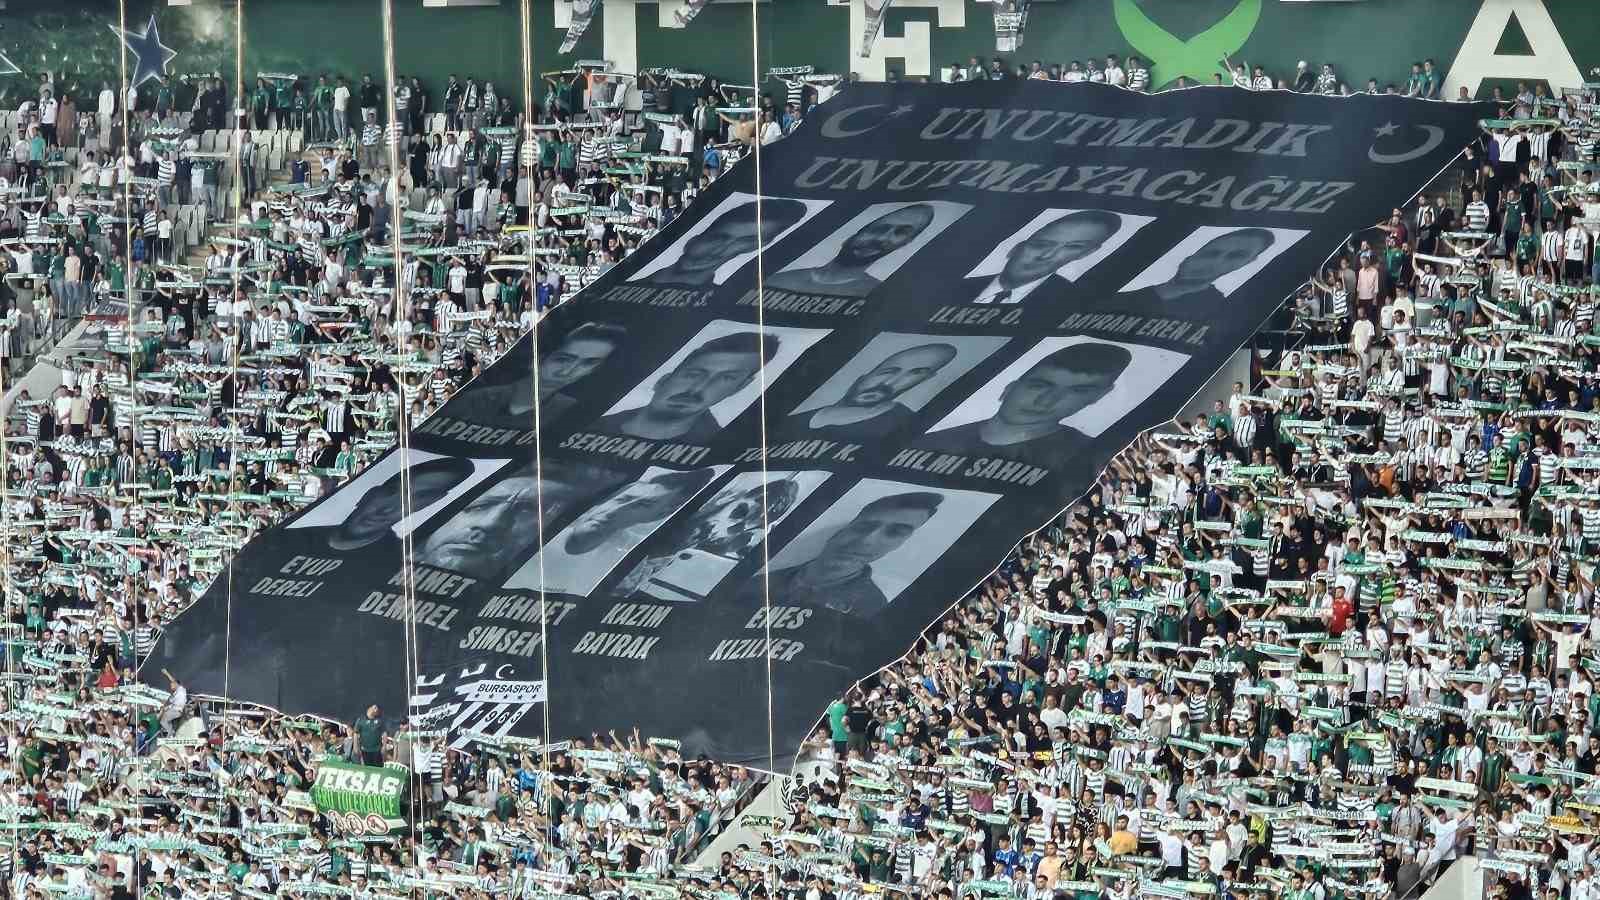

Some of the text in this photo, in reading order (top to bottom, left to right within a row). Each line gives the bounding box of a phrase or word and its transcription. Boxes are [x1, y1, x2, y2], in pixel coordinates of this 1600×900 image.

[920, 107, 1333, 158] UNUTMADIK
[794, 156, 1356, 214] UNUTMAYACAĞIZ
[929, 305, 1001, 325] ILKER
[1057, 312, 1144, 334] BAYRAM
[1136, 318, 1193, 341] EREN
[560, 432, 655, 460] SERCAN
[832, 443, 863, 463] K.
[887, 449, 1049, 487] HILMI SAHIN
[280, 555, 344, 576] EYUP
[249, 576, 325, 598] DERELI
[387, 564, 478, 599] AHMET
[357, 591, 460, 632] DEMIREL
[478, 594, 577, 626] MEHMET
[600, 602, 673, 629] KAZIM
[744, 606, 813, 630] ENES
[459, 626, 545, 658] SIMSEK
[571, 631, 660, 660] BAYRAK
[477, 683, 542, 694] BURSASPOR
[471, 709, 524, 725] 1963
[314, 766, 400, 797] TEKSAS
